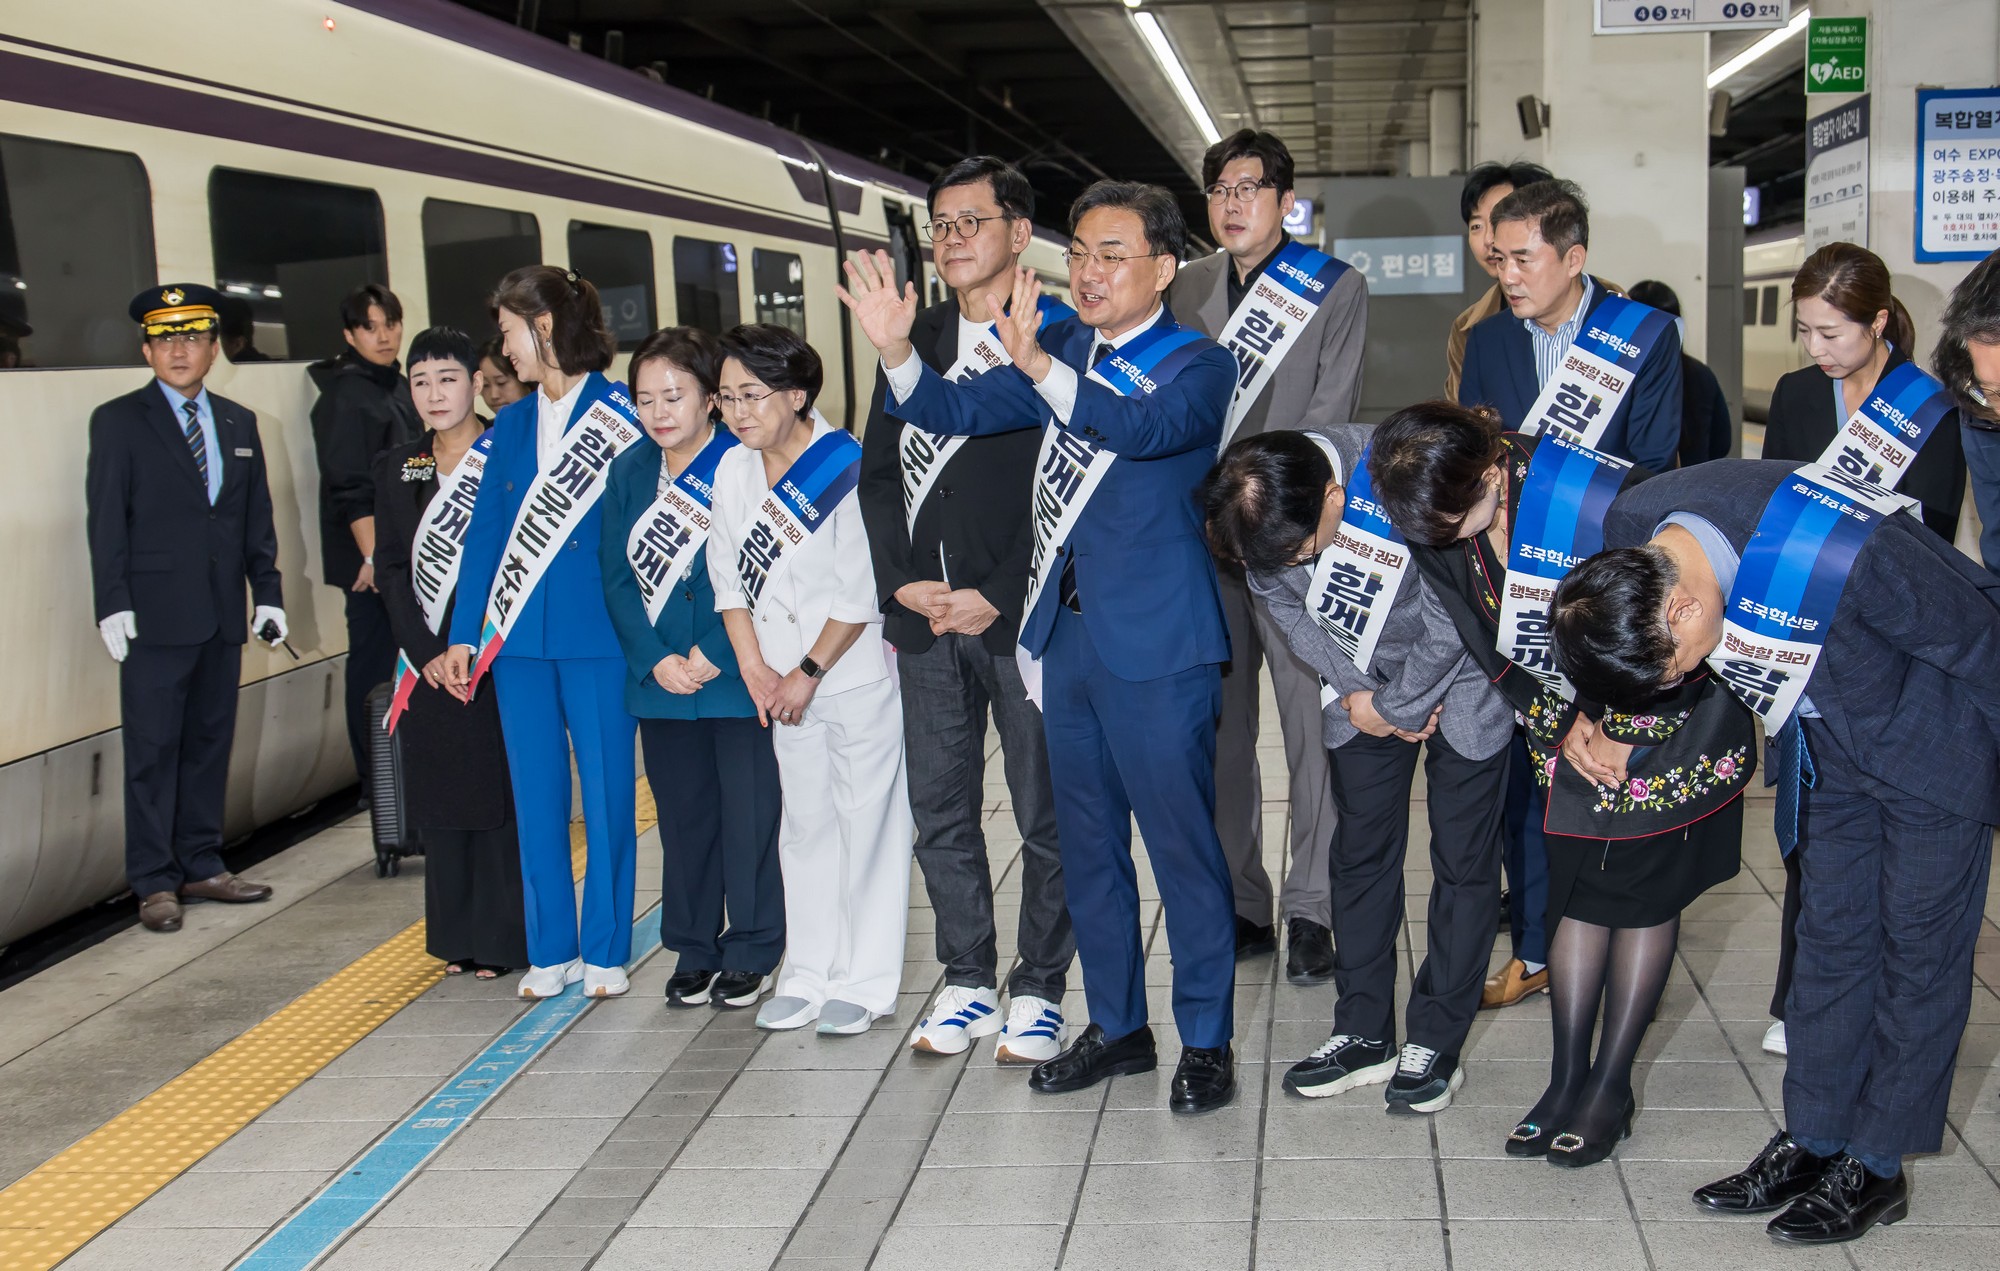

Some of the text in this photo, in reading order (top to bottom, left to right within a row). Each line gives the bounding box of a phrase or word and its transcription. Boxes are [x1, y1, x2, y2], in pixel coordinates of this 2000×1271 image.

[1670, 8, 1691, 21] 호차
[1759, 5, 1780, 17] 호차
[1832, 67, 1863, 80] AED
[1934, 148, 1961, 162] 여수
[1932, 189, 2000, 204] 이용해 주
[1956, 213, 1973, 221] 대의
[1277, 261, 1325, 293] 조국혁신당
[1381, 252, 1455, 278] 편의점
[1255, 283, 1308, 322] 행복할 권리
[1587, 327, 1641, 358] 조국혁신당
[1110, 356, 1157, 394] 조국혁신당
[1565, 356, 1625, 394] 행복할 권리
[590, 407, 620, 432] 행복할
[1870, 396, 1922, 439] 조국혁신당
[1848, 419, 1908, 468] 행복할 권리
[664, 491, 711, 531] 행복할 권리
[782, 480, 820, 521] 조국혁신당
[1792, 483, 1870, 522] 조국혁신당
[494, 425, 618, 627] 함께 웃는 추석
[762, 498, 803, 545] 행복할 권리
[632, 511, 693, 588] 함께
[737, 520, 785, 601] 함께
[1333, 531, 1404, 569] 행복할 권리
[1317, 562, 1384, 636] 함께
[1738, 597, 1819, 631] 조국혁신당
[1724, 632, 1811, 666] 행복할 권리
